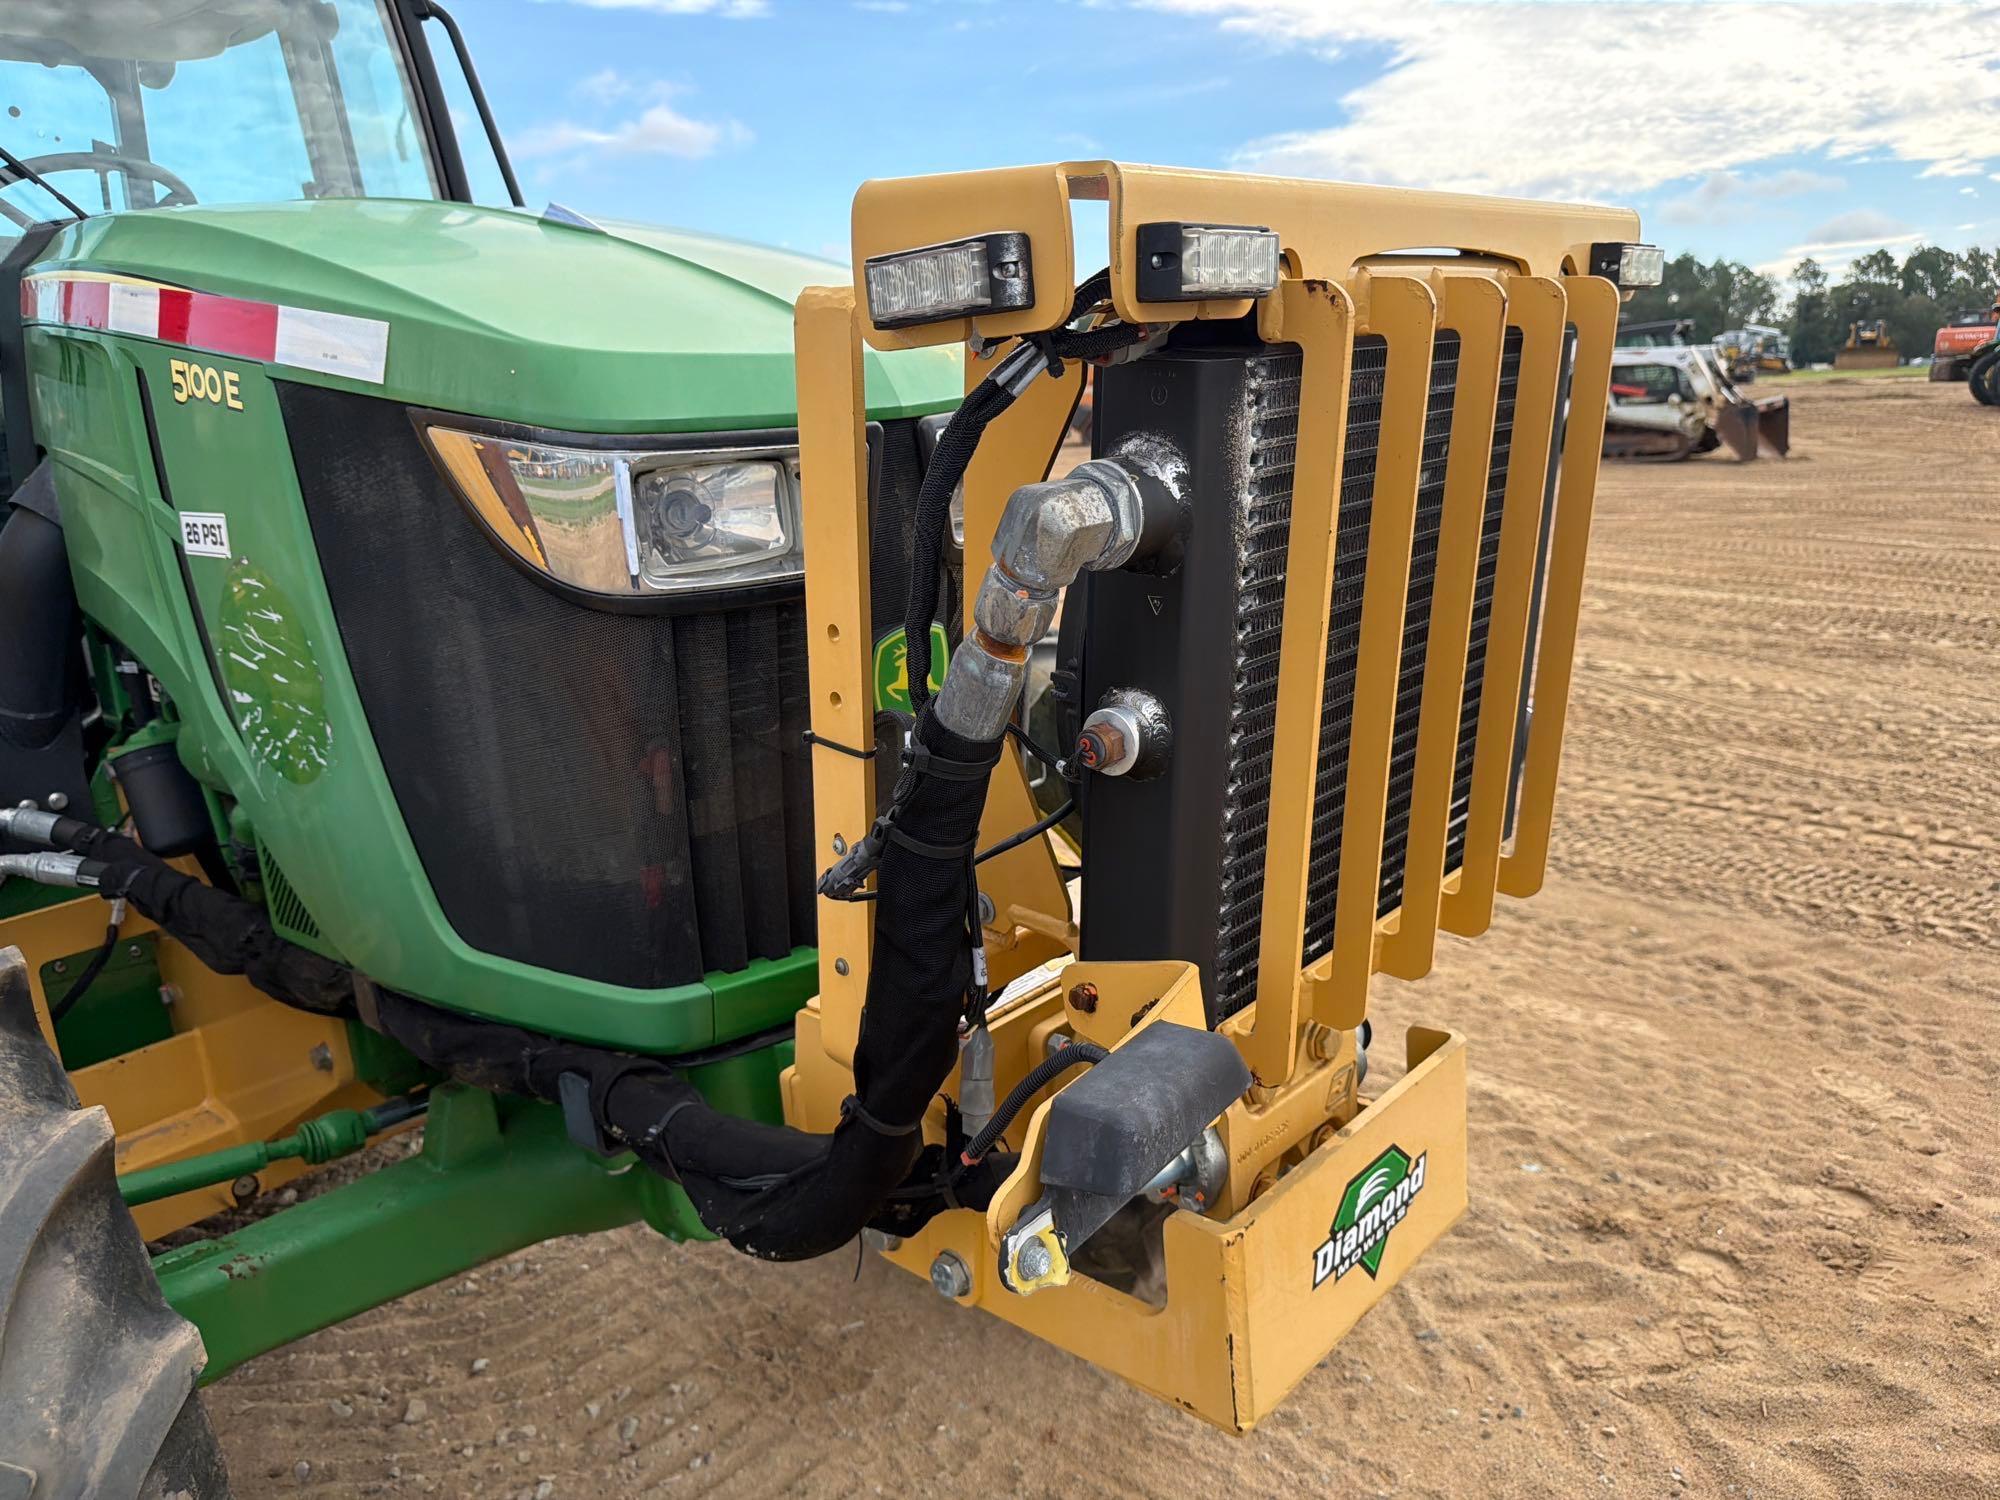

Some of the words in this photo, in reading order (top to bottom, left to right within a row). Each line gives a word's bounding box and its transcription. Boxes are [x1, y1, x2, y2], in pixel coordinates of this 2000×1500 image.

[170, 359, 244, 411] 5100E
[185, 522, 200, 544] 26
[201, 523, 225, 546] PSI
[1315, 1154, 1426, 1285] Diamond
[1337, 1205, 1408, 1278] MOWERS
